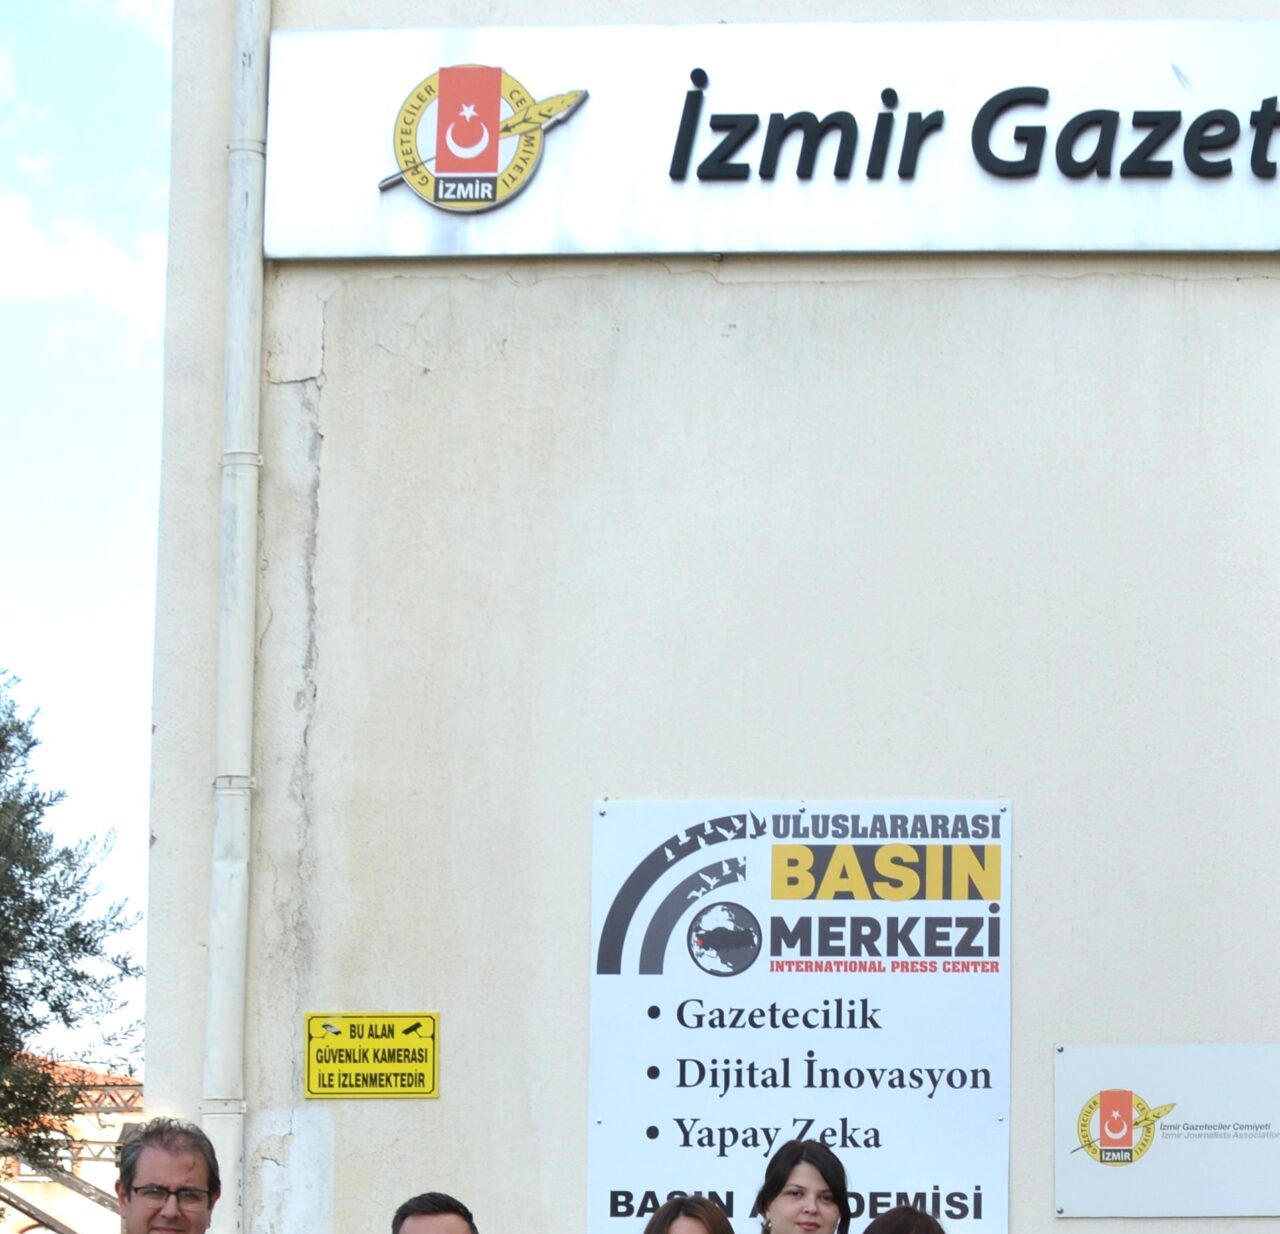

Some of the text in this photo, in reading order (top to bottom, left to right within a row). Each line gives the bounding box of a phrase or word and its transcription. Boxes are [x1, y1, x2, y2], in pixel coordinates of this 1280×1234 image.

[669, 67, 944, 181] İzmir
[438, 179, 493, 199] İZMİR
[772, 814, 1001, 839] ULUSLARARASI
[771, 844, 1001, 901] BASIN
[770, 902, 1001, 957] MERKEZİ
[769, 961, 1000, 973] INTERNATIONAL PRESS CENTER
[676, 998, 882, 1029] Gazetecilik
[350, 1024, 395, 1039] BU ALAN
[316, 1045, 428, 1063] GÜVENLİK KAMERASI
[318, 1069, 425, 1088] İLE İZLENMEKTEDİR
[676, 1049, 992, 1099] Dijital İnovasyon
[673, 1117, 882, 1158] Yapay Zeka
[1102, 1150, 1131, 1161] İZMİR
[610, 1190, 734, 1218] BAN
